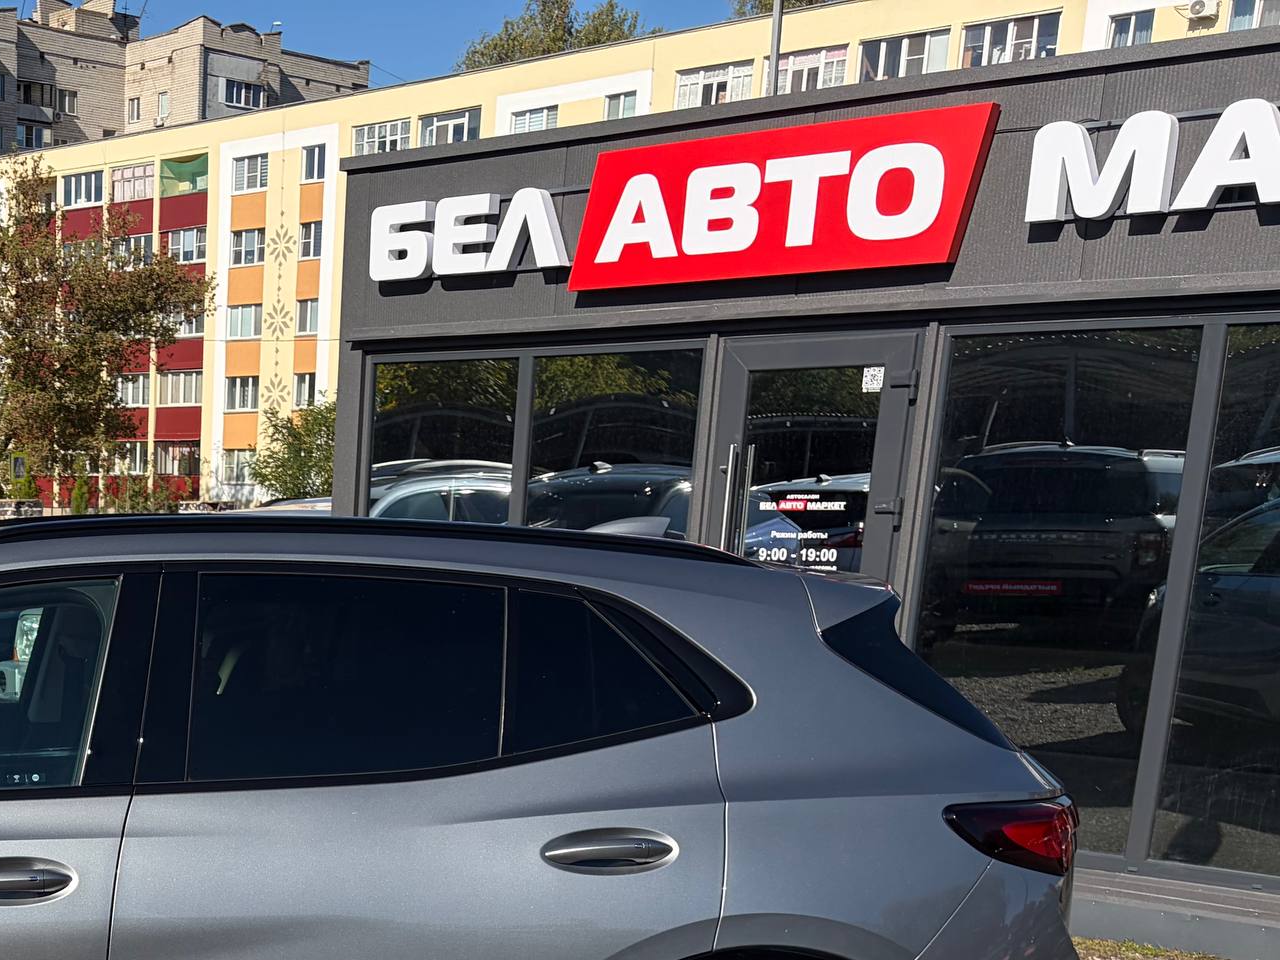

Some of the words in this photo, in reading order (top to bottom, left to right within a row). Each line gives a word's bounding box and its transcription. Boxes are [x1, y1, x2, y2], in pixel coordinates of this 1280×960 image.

[369, 187, 570, 282] БЕЛ
[594, 142, 945, 264] АВТО
[779, 500, 805, 510] АВТО
[806, 501, 847, 511] МАРКЕТ
[770, 530, 797, 539] Режим
[797, 530, 828, 540] работы
[758, 548, 787, 561] 9:00
[800, 549, 838, 562] 19:00
